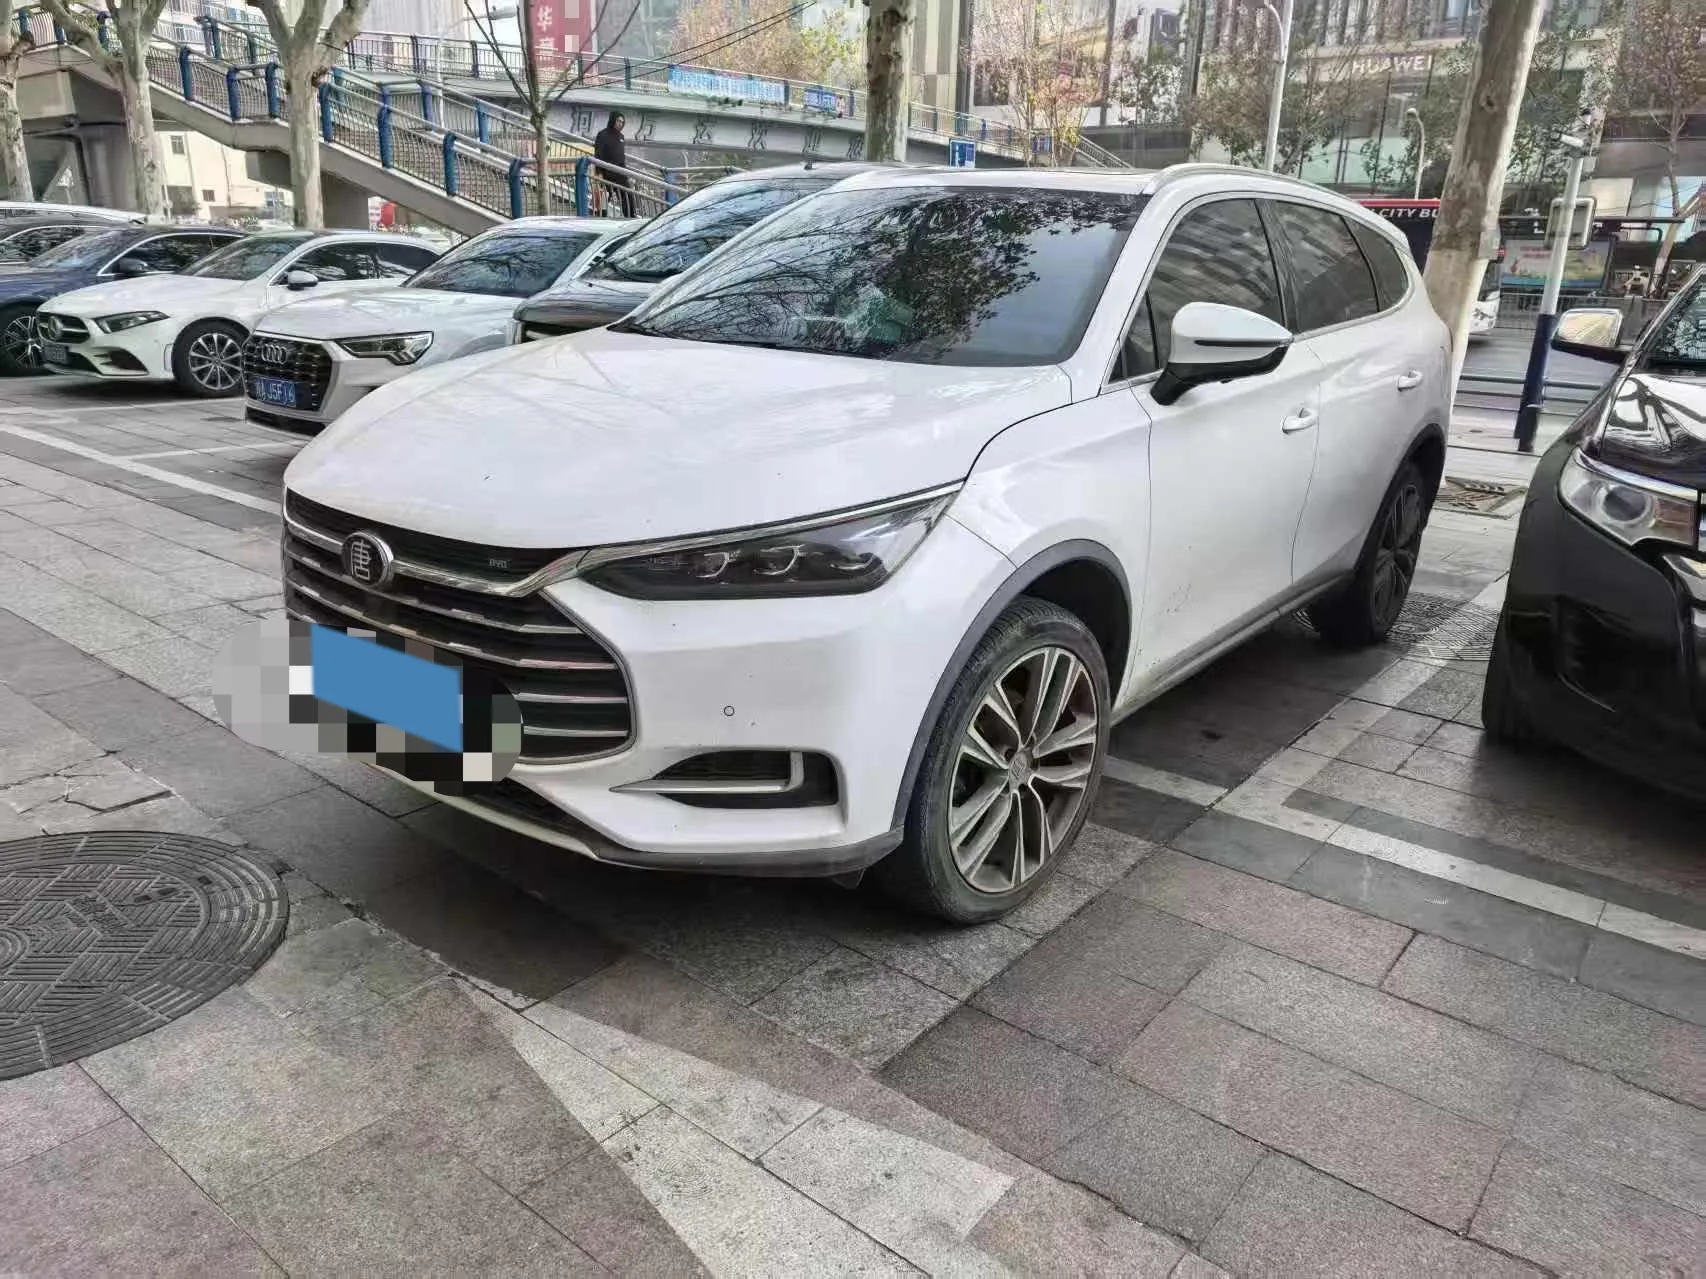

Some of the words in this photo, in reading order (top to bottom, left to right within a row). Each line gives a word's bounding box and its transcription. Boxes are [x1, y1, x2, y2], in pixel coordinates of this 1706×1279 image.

[1352, 54, 1433, 75] HUAWEI
[1378, 207, 1416, 218] CITY
[350, 538, 372, 581] 唐
